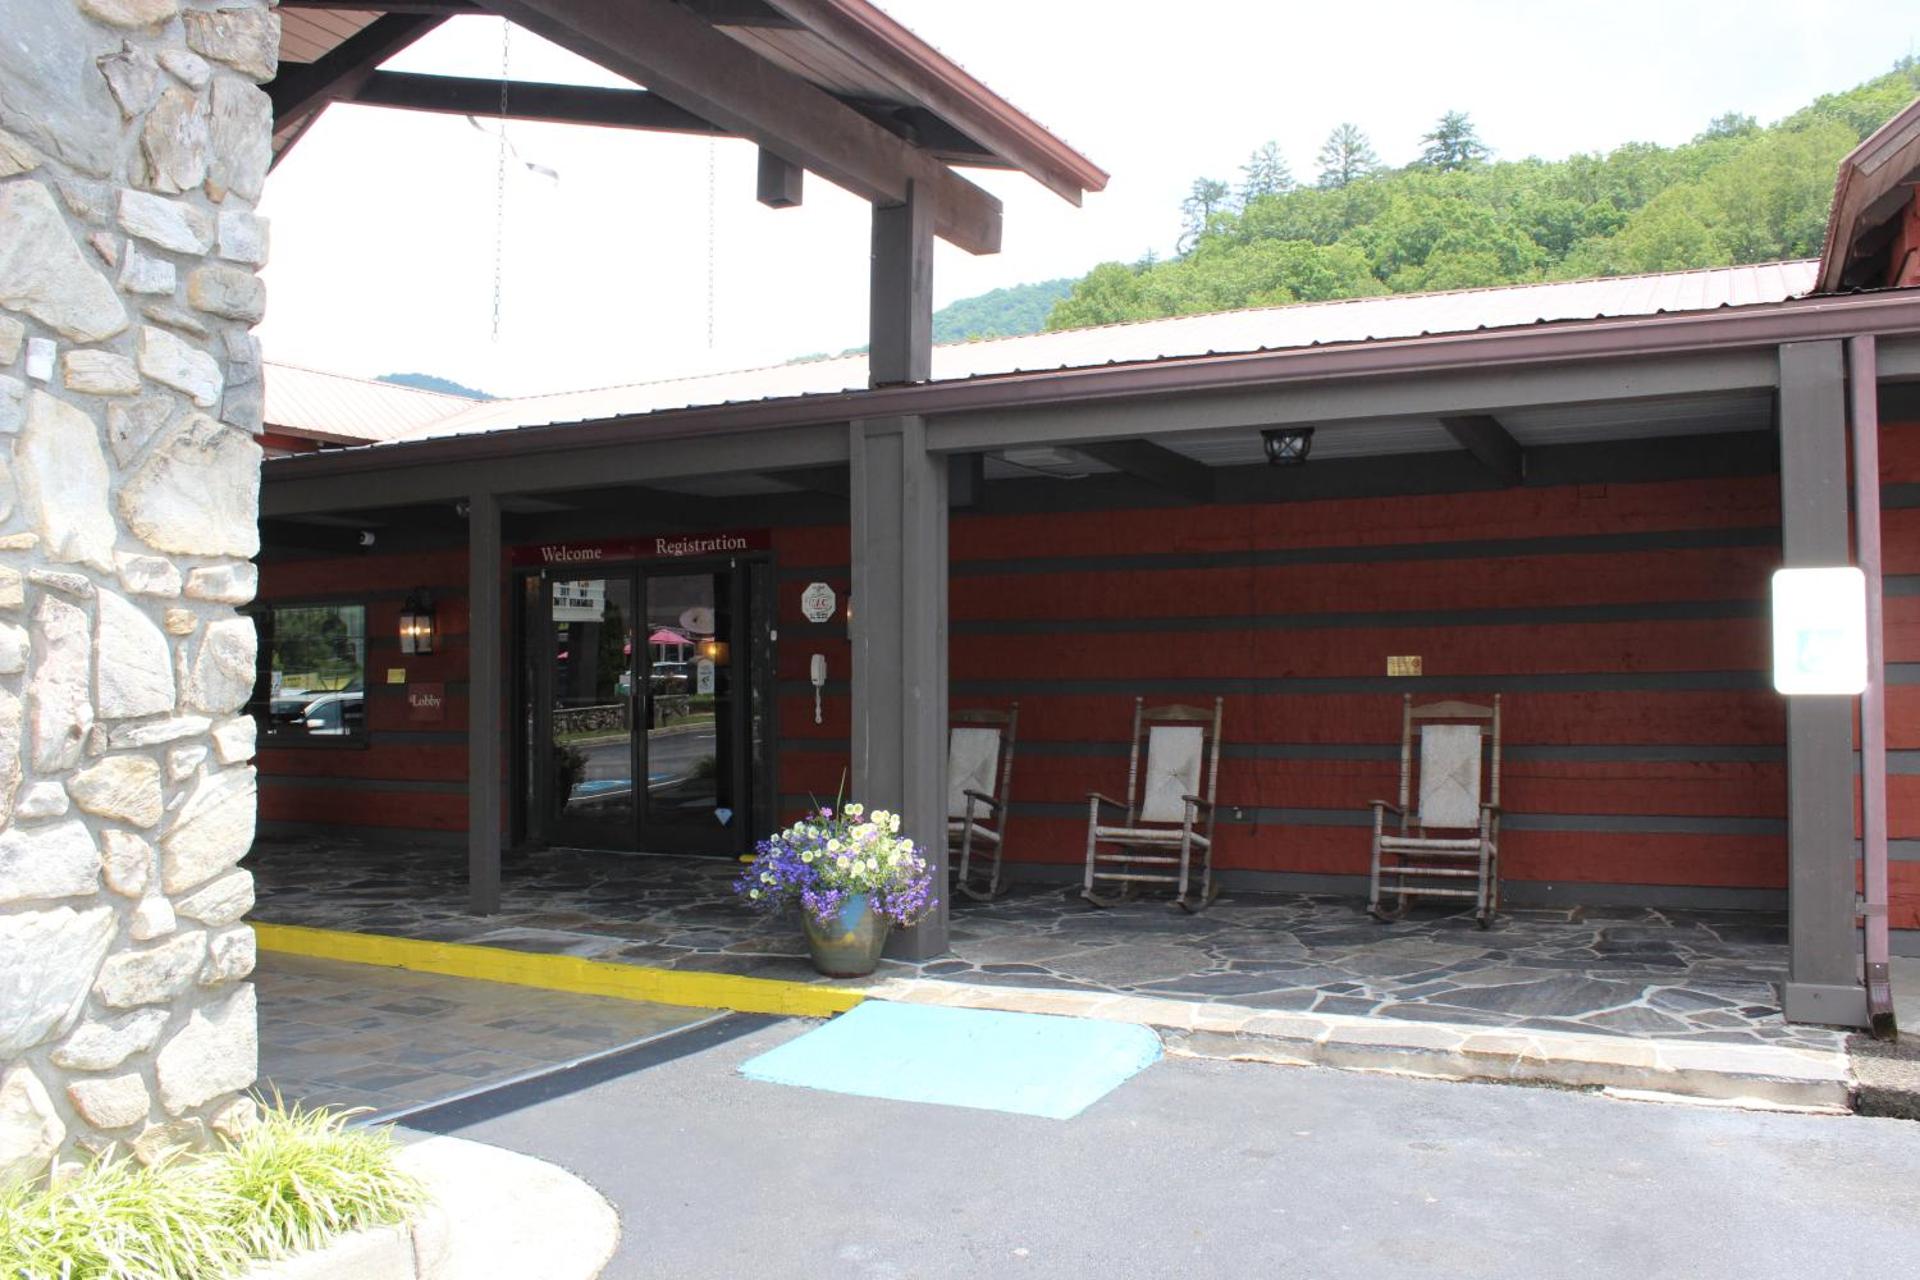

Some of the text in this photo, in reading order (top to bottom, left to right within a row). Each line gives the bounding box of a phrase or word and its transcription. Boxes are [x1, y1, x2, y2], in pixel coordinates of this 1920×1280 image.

[656, 535, 747, 556] Registration
[541, 546, 602, 562] Welcome
[411, 694, 441, 709] Lobby
